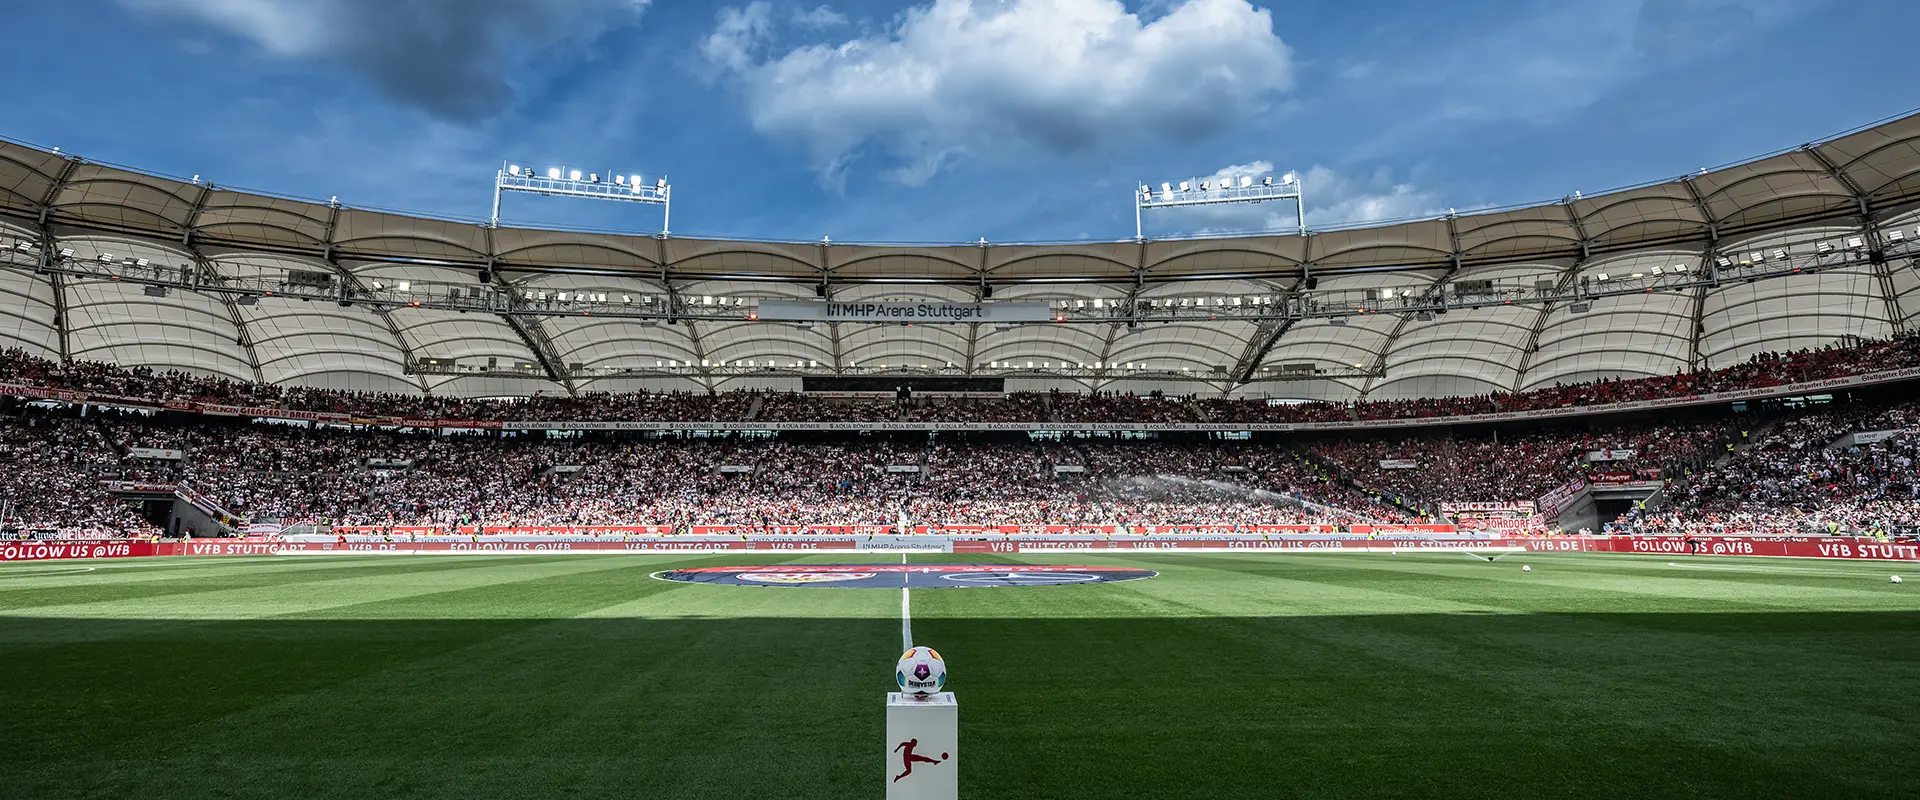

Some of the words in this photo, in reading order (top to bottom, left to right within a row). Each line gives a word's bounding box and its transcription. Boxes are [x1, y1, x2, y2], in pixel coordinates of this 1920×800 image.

[918, 304, 982, 320] Stuttgart
[1862, 372, 1898, 382] Stuttgarter
[1788, 382, 1822, 391] Stuttgarter
[204, 405, 238, 414] GERLINGEN
[290, 412, 318, 420] BRENZ
[1442, 502, 1518, 511] SCHICKERIA
[1487, 519, 1530, 529] ROHRDORF
[193, 544, 221, 554] VfB
[227, 544, 306, 554] STUTTGART
[991, 542, 1014, 552] VfB
[1531, 541, 1579, 551] VfB.DE
[1633, 541, 1685, 552] FOLLOW
[1713, 542, 1753, 554] @VfB
[1818, 544, 1851, 556] VfB
[70, 546, 88, 557] US
[93, 545, 130, 558] @VfB
